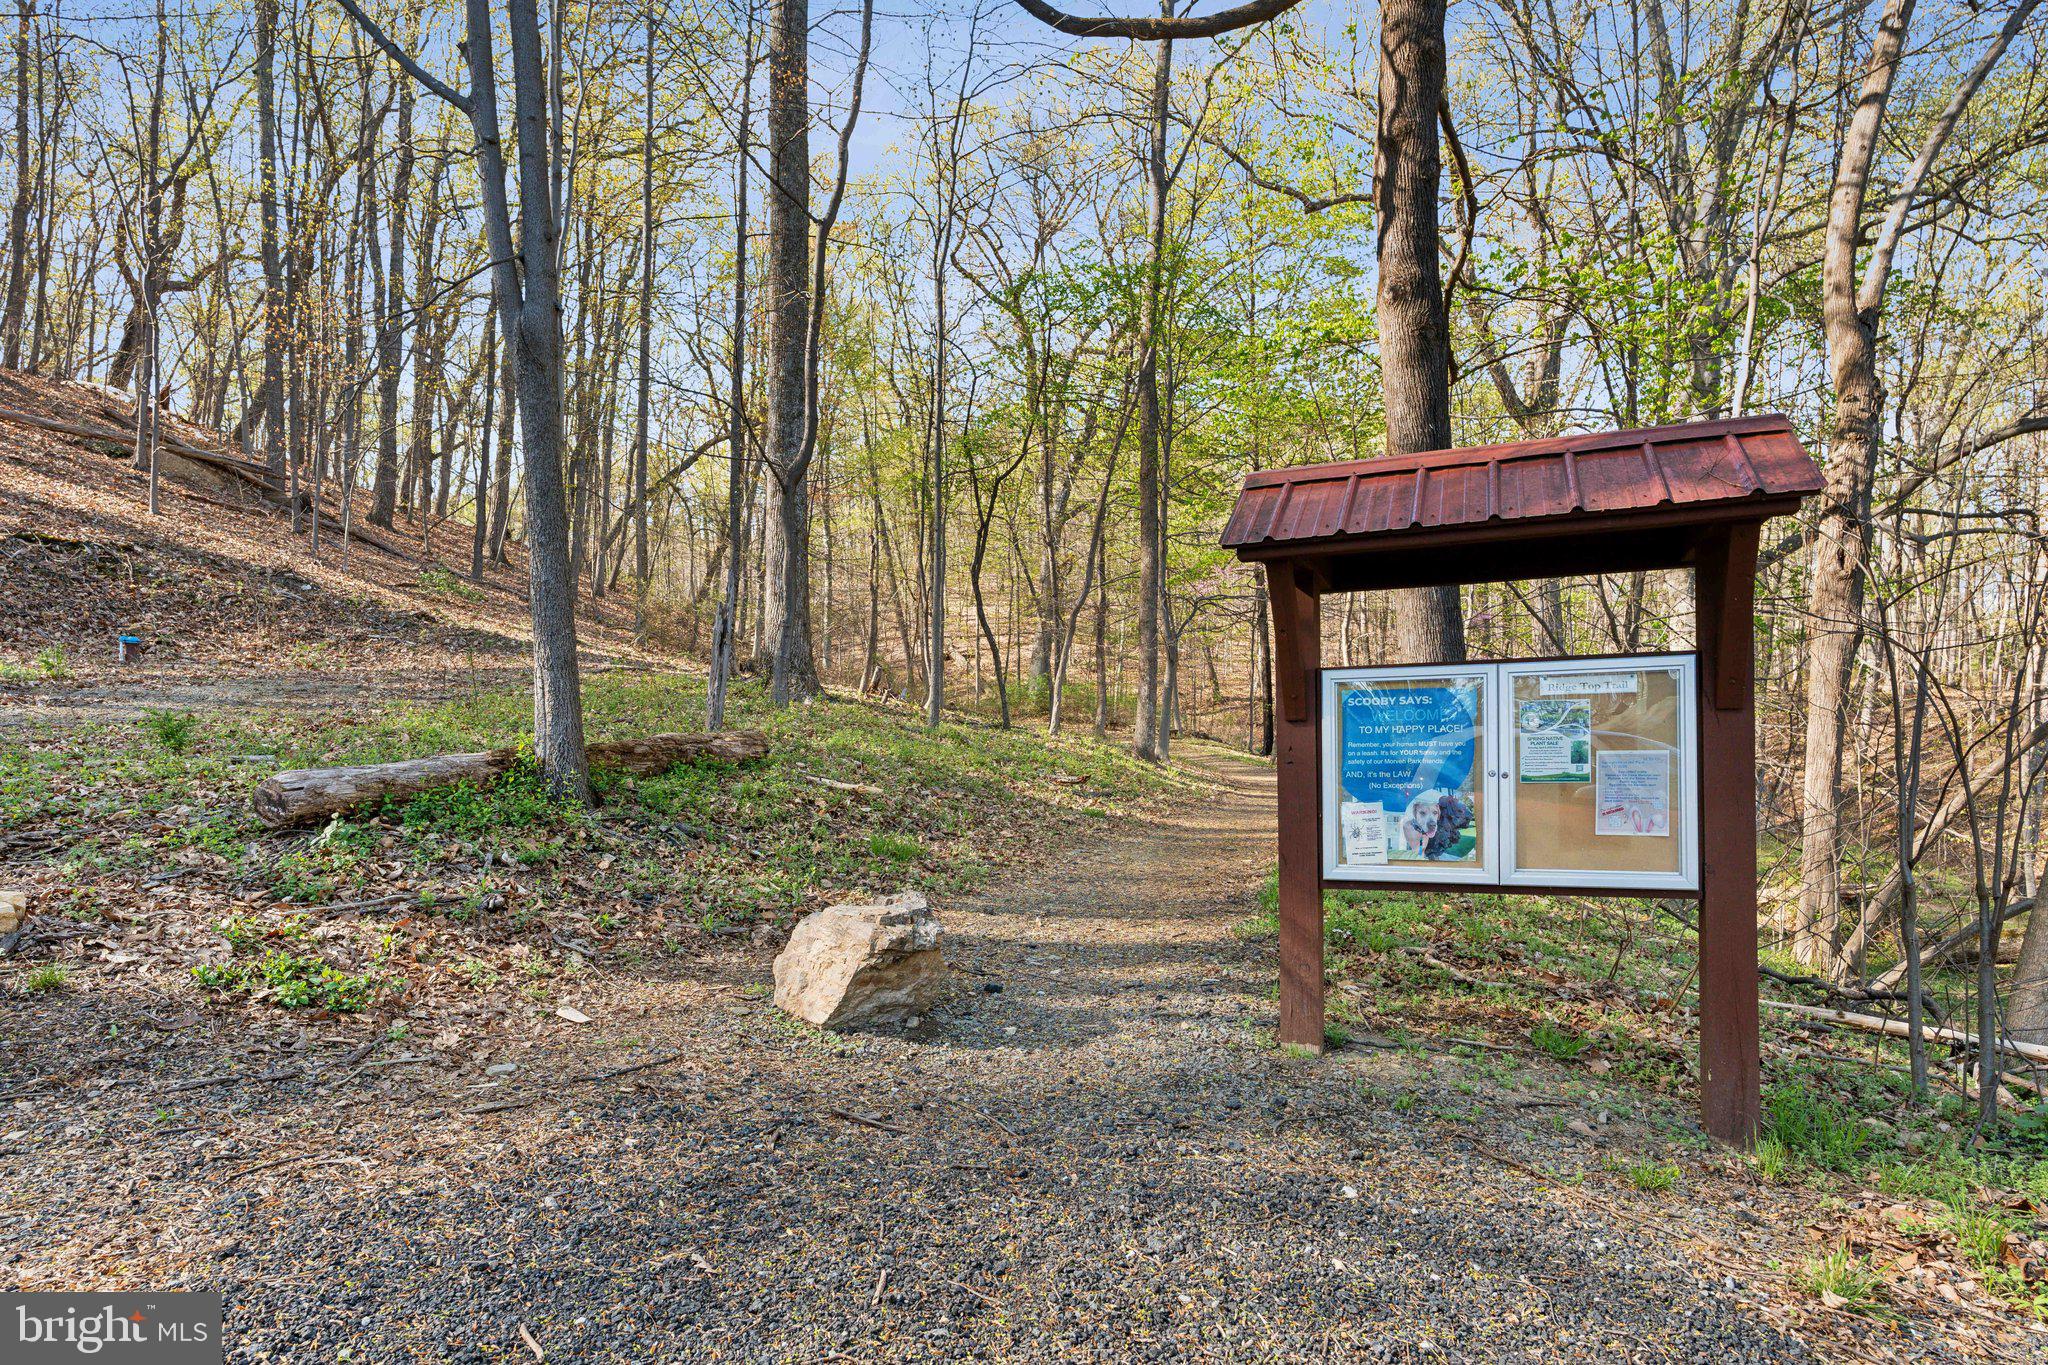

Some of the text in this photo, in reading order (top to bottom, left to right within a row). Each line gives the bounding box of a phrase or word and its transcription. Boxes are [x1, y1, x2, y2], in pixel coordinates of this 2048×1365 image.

[1580, 682, 1601, 691] Top
[1604, 681, 1629, 689] Trail
[1348, 696, 1433, 706] SCOOBY SAYS:
[1374, 726, 1389, 734] MY
[1392, 725, 1426, 734] HAPPY
[1428, 724, 1464, 732] PLACE!
[1384, 782, 1424, 790] Exceptions)
